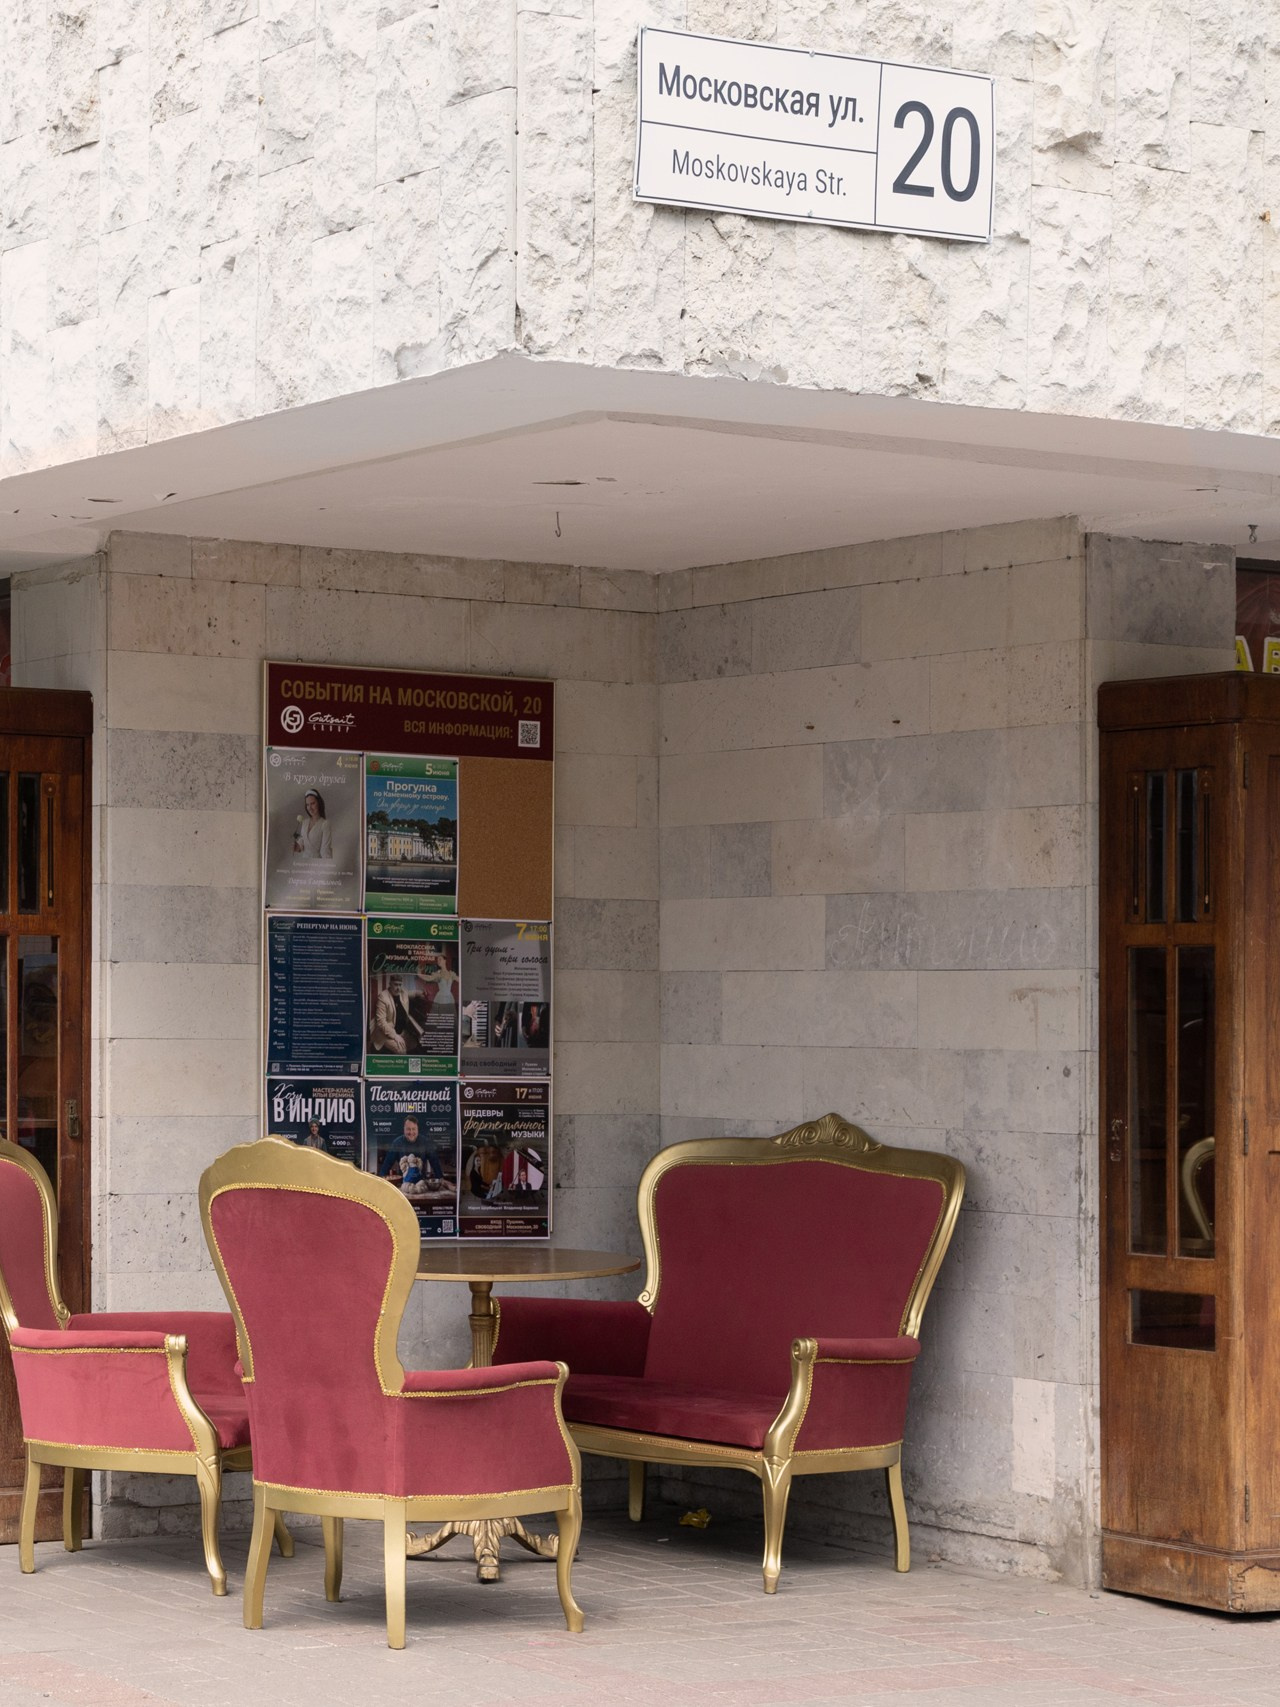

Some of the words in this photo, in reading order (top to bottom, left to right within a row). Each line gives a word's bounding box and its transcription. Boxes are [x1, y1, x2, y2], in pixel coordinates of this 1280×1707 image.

[658, 62, 820, 117] Московская
[828, 93, 864, 128] ул.
[892, 100, 981, 203] 20
[671, 149, 807, 196] Moskovskaya
[815, 168, 847, 197] Str.
[280, 679, 365, 704] СОБЫТИЯ
[369, 686, 393, 705] НА
[397, 687, 519, 717] МОСКОВСКОЙ,
[522, 696, 542, 715] 20
[404, 719, 426, 734] ВСЯ
[428, 721, 514, 741] ИНФОРМАЦИЯ:
[336, 755, 343, 768] 4
[425, 763, 433, 776] 5
[293, 774, 318, 786] кругу
[319, 773, 347, 787] друзей
[386, 781, 437, 794] Прогулка
[383, 791, 422, 801] Каменному
[296, 922, 329, 930] РЕПЕРТУАР
[430, 924, 438, 936] 6
[516, 923, 527, 941] 7
[466, 941, 482, 956] Три
[484, 945, 508, 957] души
[499, 955, 518, 966] три
[521, 956, 548, 964] голоса
[480, 1059, 517, 1067] свободный
[272, 1083, 302, 1111] Хочу
[370, 1085, 451, 1102] Пельменный
[515, 1087, 527, 1100] 17
[273, 1098, 284, 1123] В
[289, 1098, 355, 1126] ИНДИЮ
[394, 1102, 427, 1113] МИШЛЕН
[464, 1109, 503, 1118] ШЕДЕВРЫ
[463, 1116, 547, 1138] фортепианной
